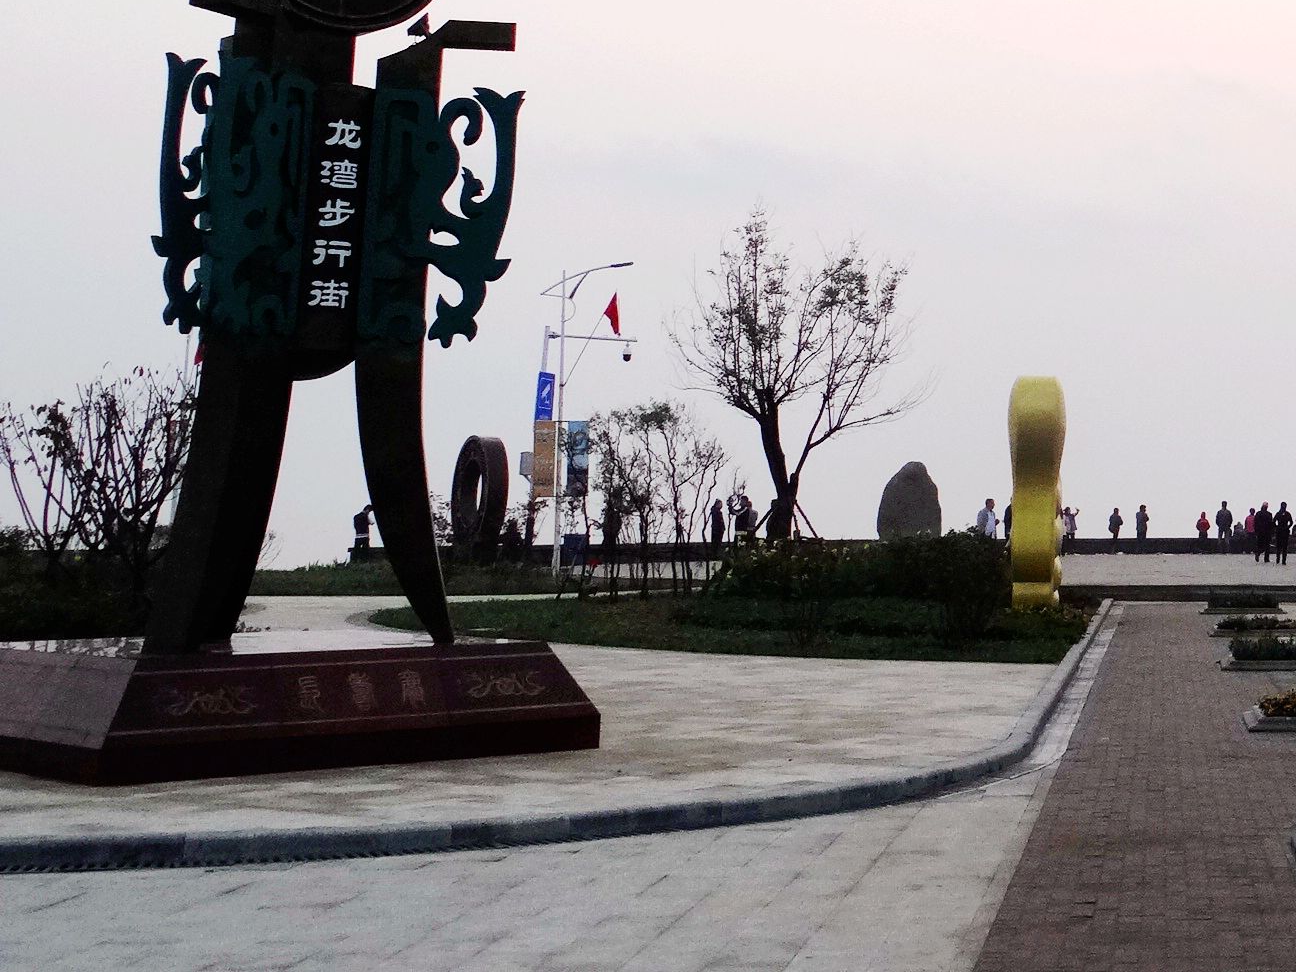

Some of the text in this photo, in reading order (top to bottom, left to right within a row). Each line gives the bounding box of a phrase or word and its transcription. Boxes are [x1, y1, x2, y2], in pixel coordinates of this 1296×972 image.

[308, 118, 361, 309] 龙湾步行街
